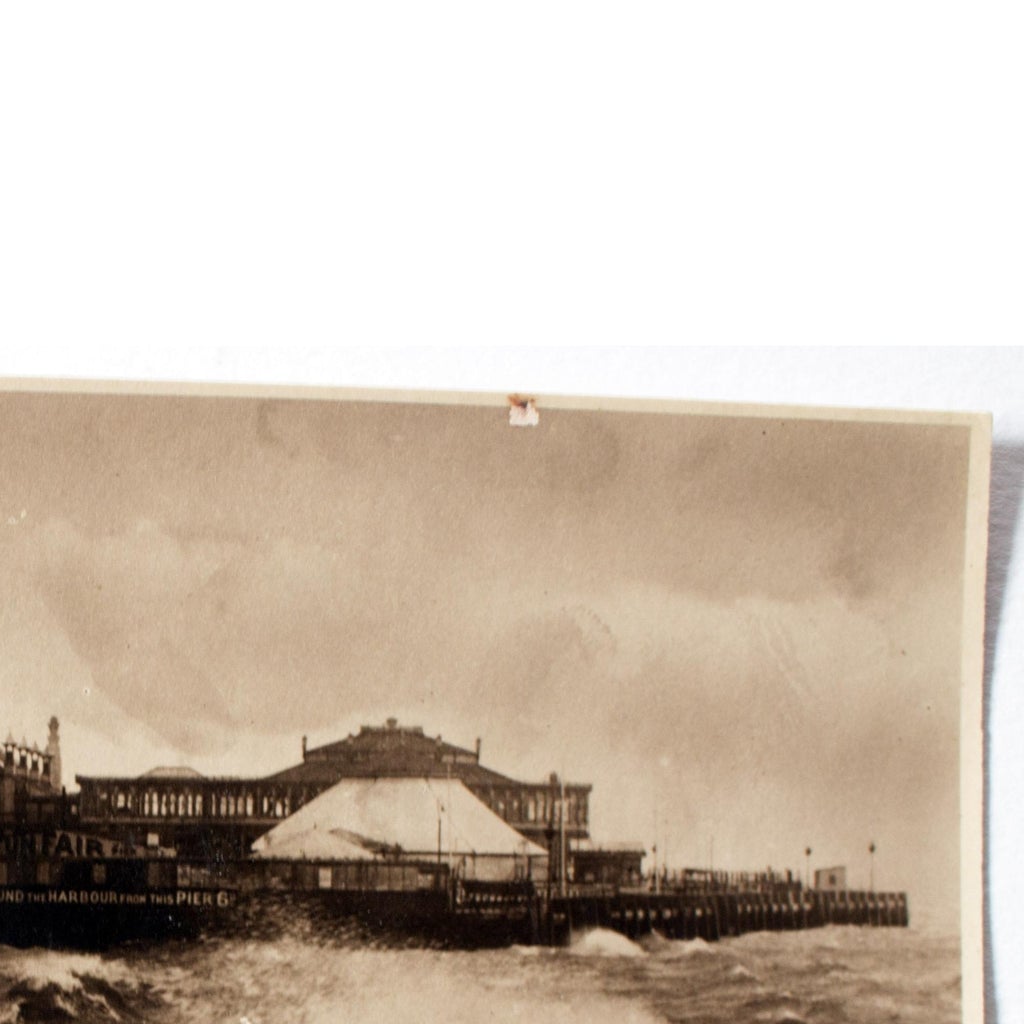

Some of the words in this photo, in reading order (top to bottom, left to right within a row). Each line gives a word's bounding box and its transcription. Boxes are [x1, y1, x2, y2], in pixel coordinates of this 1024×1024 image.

[26, 891, 47, 904] THE
[48, 889, 118, 905] HARBOUR
[119, 892, 147, 904] FROM
[148, 893, 175, 906] THIS
[176, 890, 213, 906] PIER
